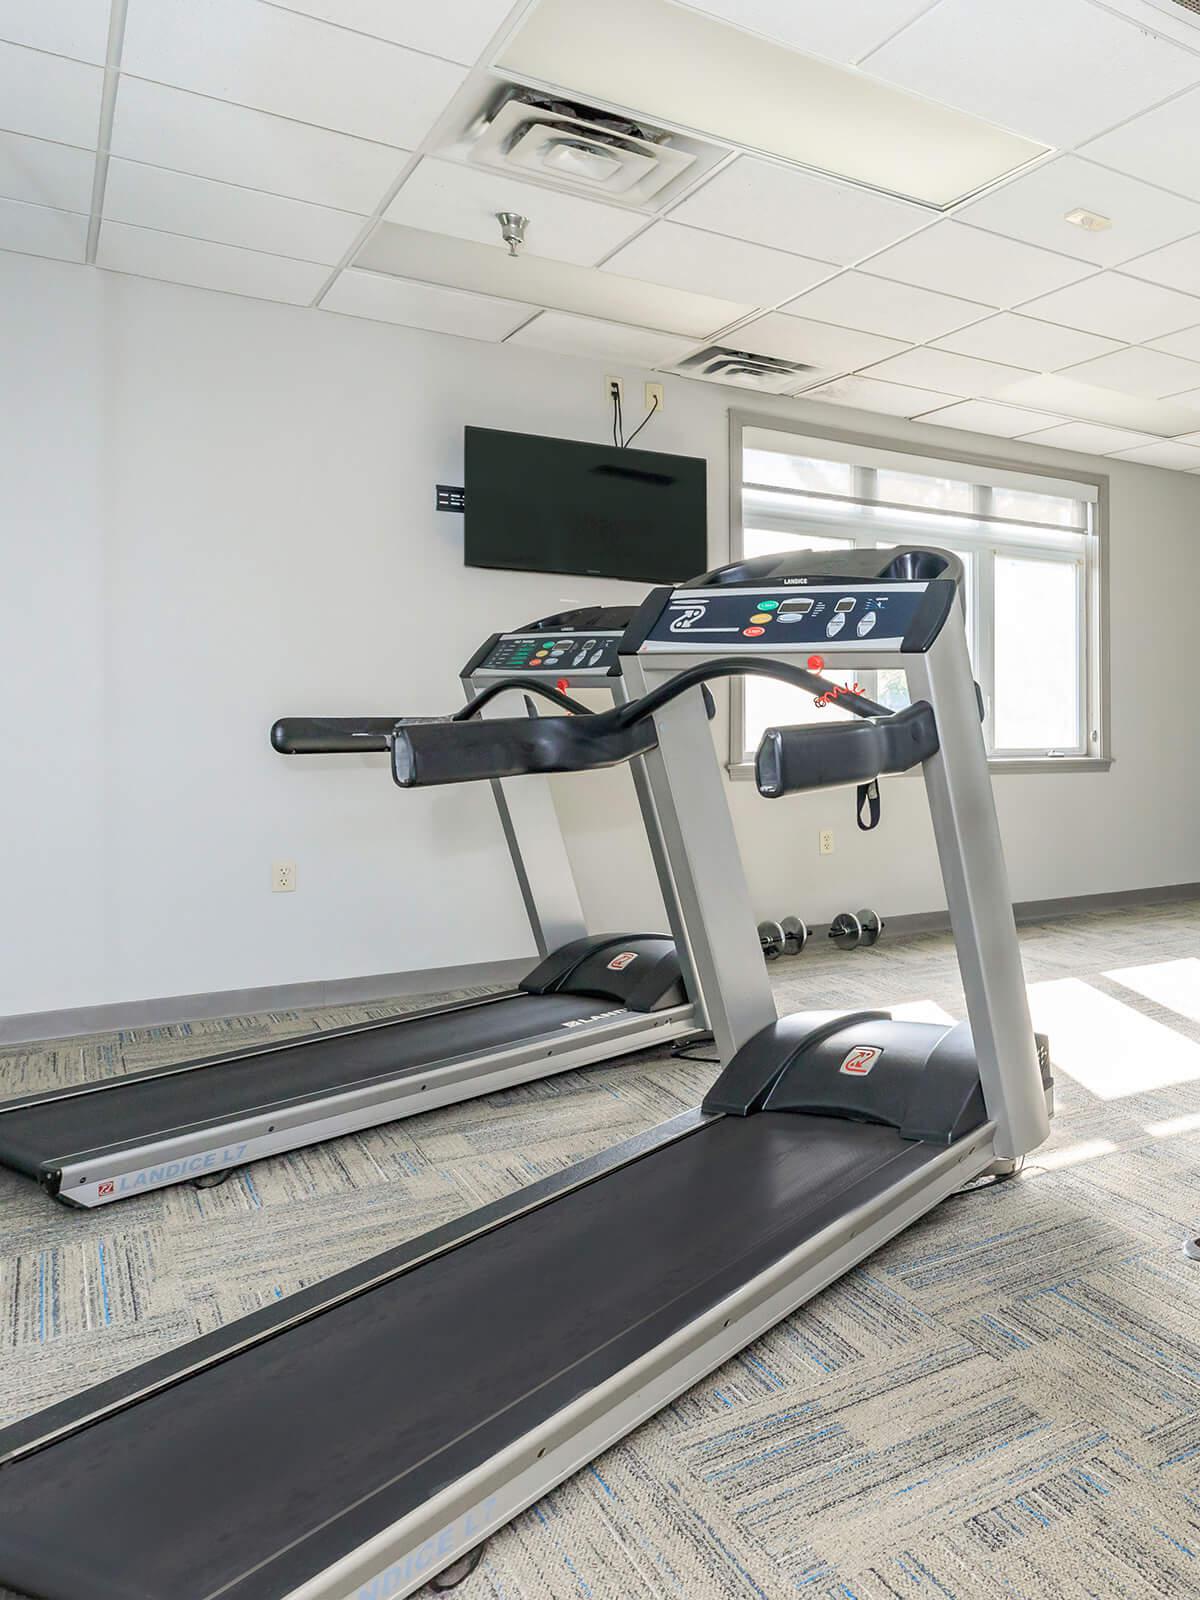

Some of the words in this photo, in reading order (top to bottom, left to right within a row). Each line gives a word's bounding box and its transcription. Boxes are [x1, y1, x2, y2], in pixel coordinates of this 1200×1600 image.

[784, 577, 808, 585] LANDICE
[119, 1152, 216, 1191] LANDICE
[223, 1145, 248, 1164] L7
